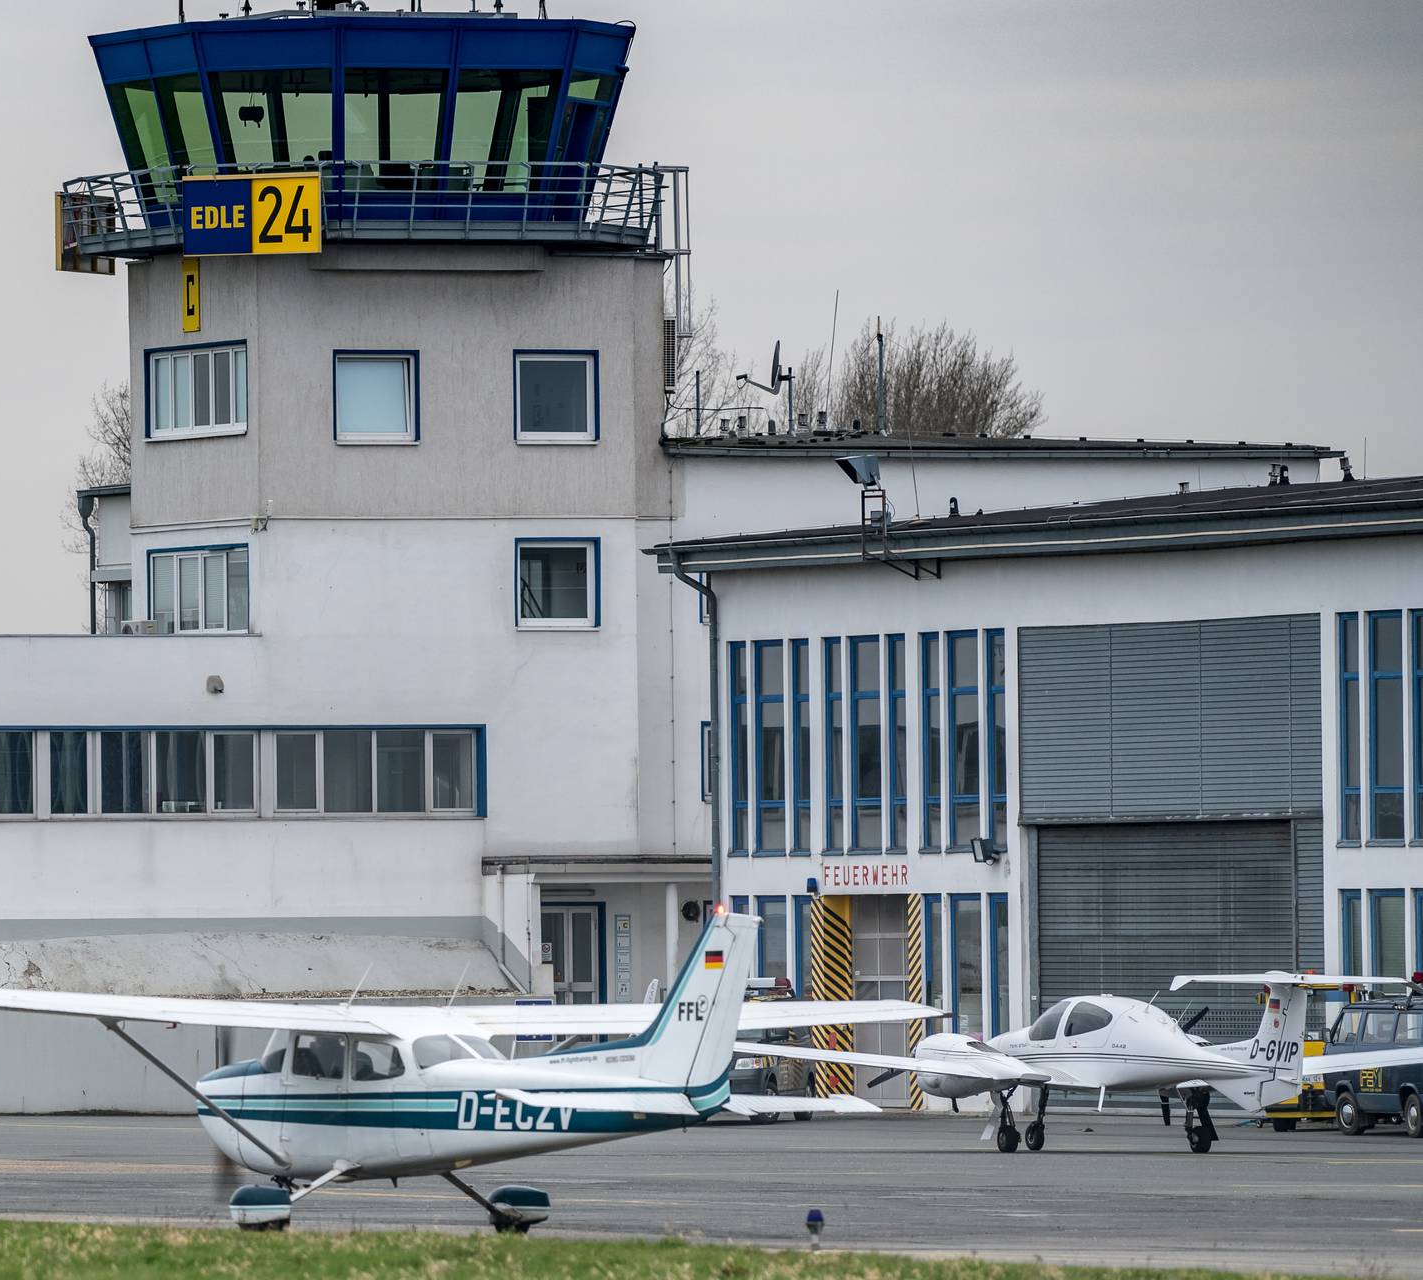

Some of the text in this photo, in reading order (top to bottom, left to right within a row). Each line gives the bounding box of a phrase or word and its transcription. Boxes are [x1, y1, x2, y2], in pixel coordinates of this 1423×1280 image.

[190, 185, 313, 244] EDLE 24
[186, 274, 195, 317] C
[823, 864, 909, 887] FEUERWEHR
[678, 1001, 704, 1022] FFL
[1249, 1038, 1299, 1063] D-GVIP
[457, 1091, 573, 1131] D-ECZV
